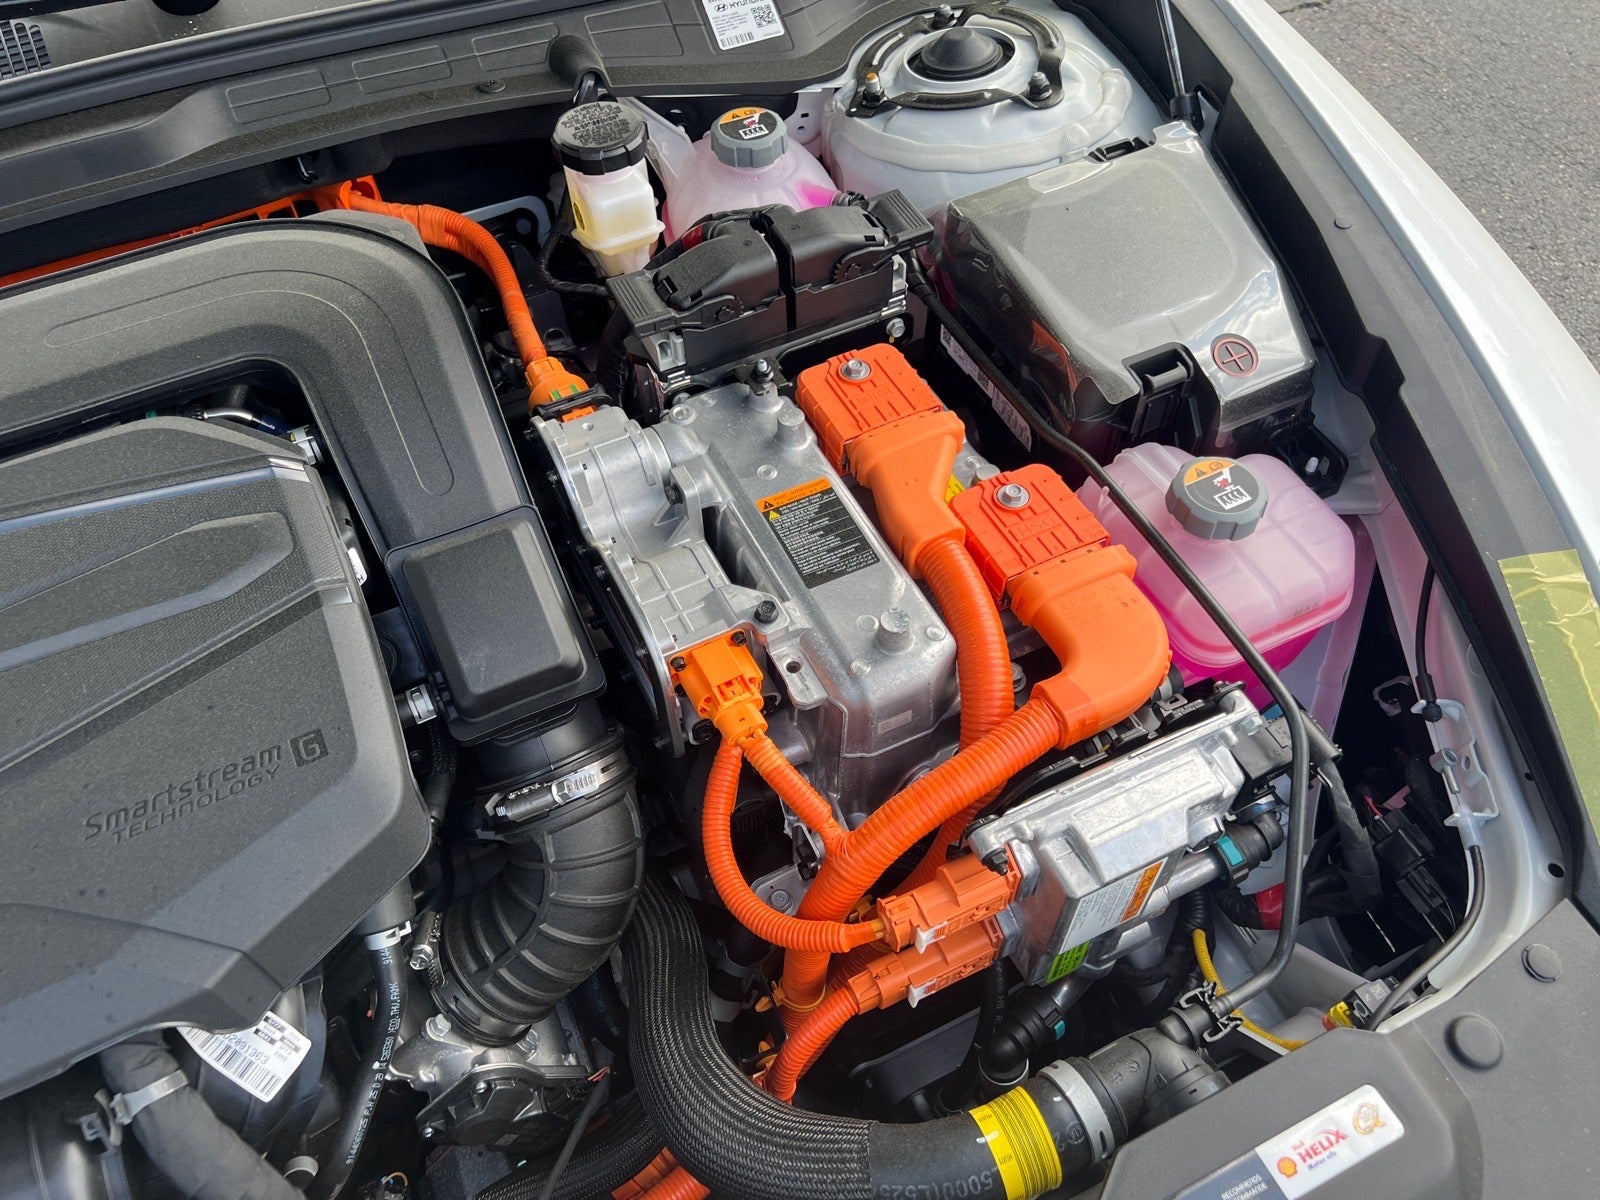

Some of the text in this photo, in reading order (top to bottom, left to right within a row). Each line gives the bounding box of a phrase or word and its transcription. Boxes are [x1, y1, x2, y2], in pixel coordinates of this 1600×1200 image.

[84, 744, 281, 842] Smartstream
[113, 764, 280, 844] TECHNOLOGY
[1298, 1129, 1348, 1163] HELIX
